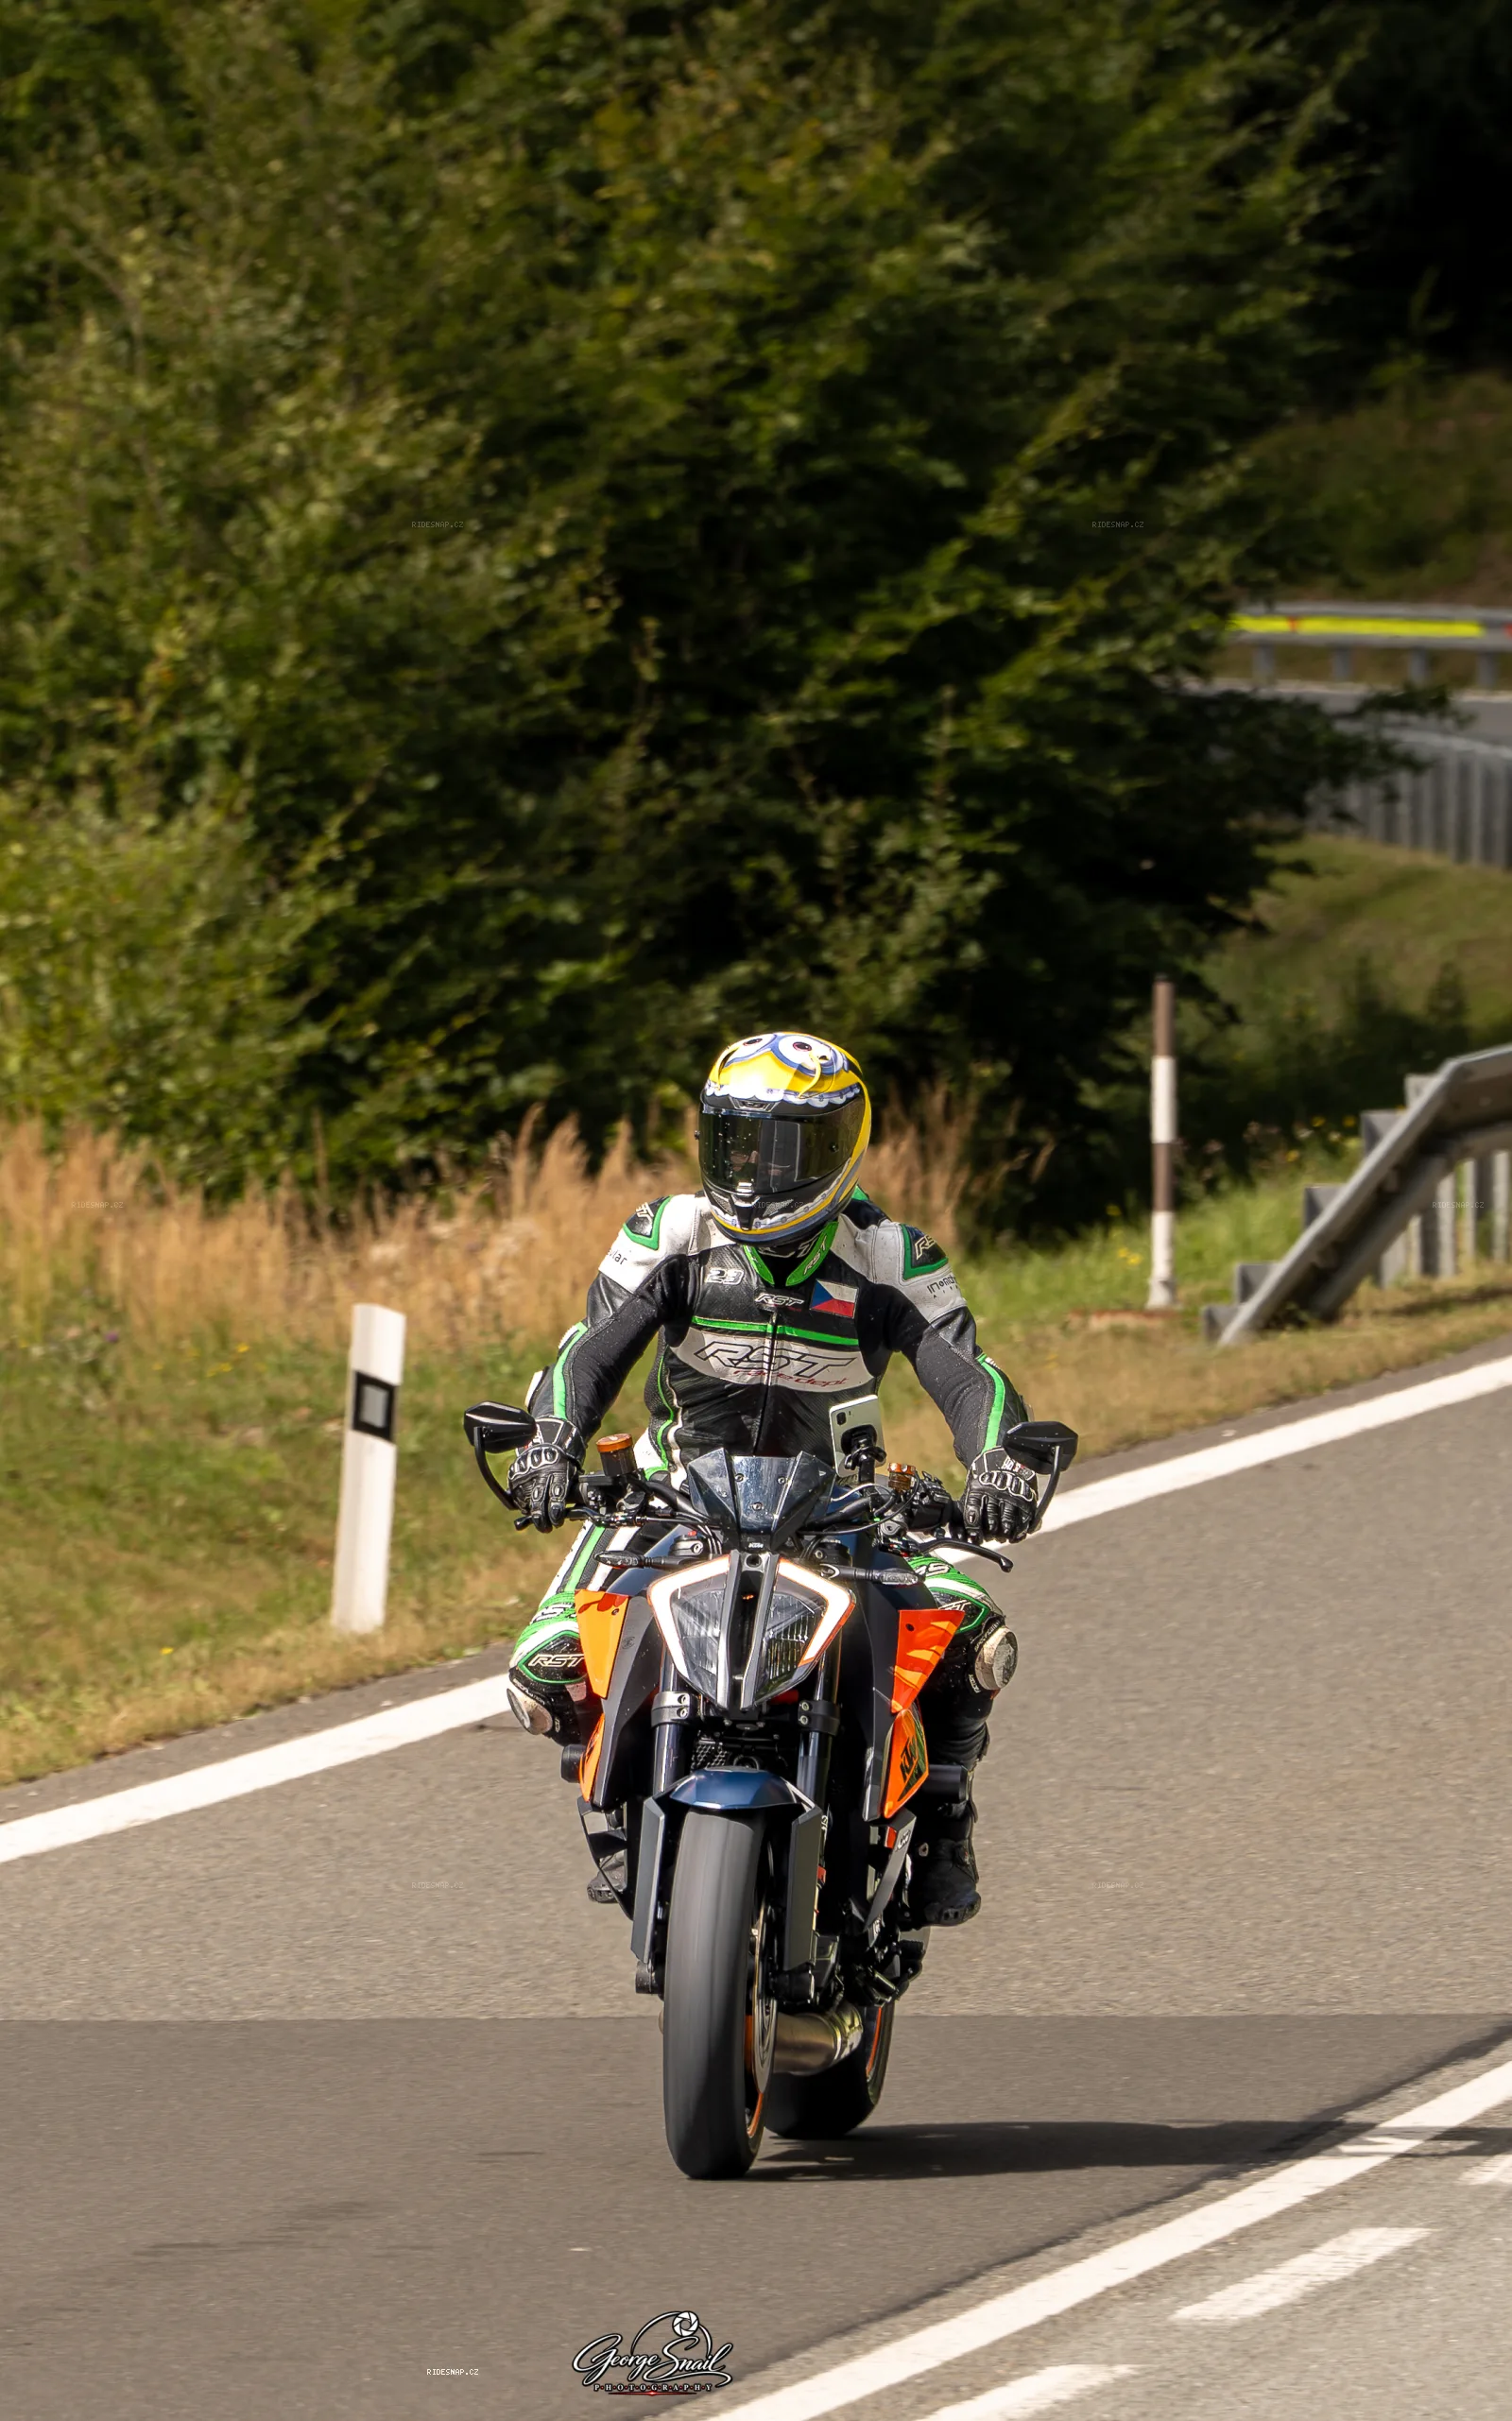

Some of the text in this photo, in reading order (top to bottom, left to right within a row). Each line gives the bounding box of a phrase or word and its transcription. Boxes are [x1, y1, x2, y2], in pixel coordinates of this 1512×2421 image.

[754, 1292, 805, 1307] RST
[694, 1341, 858, 1379] RST
[794, 1377, 850, 1387] dept
[527, 1653, 585, 1669] RST
